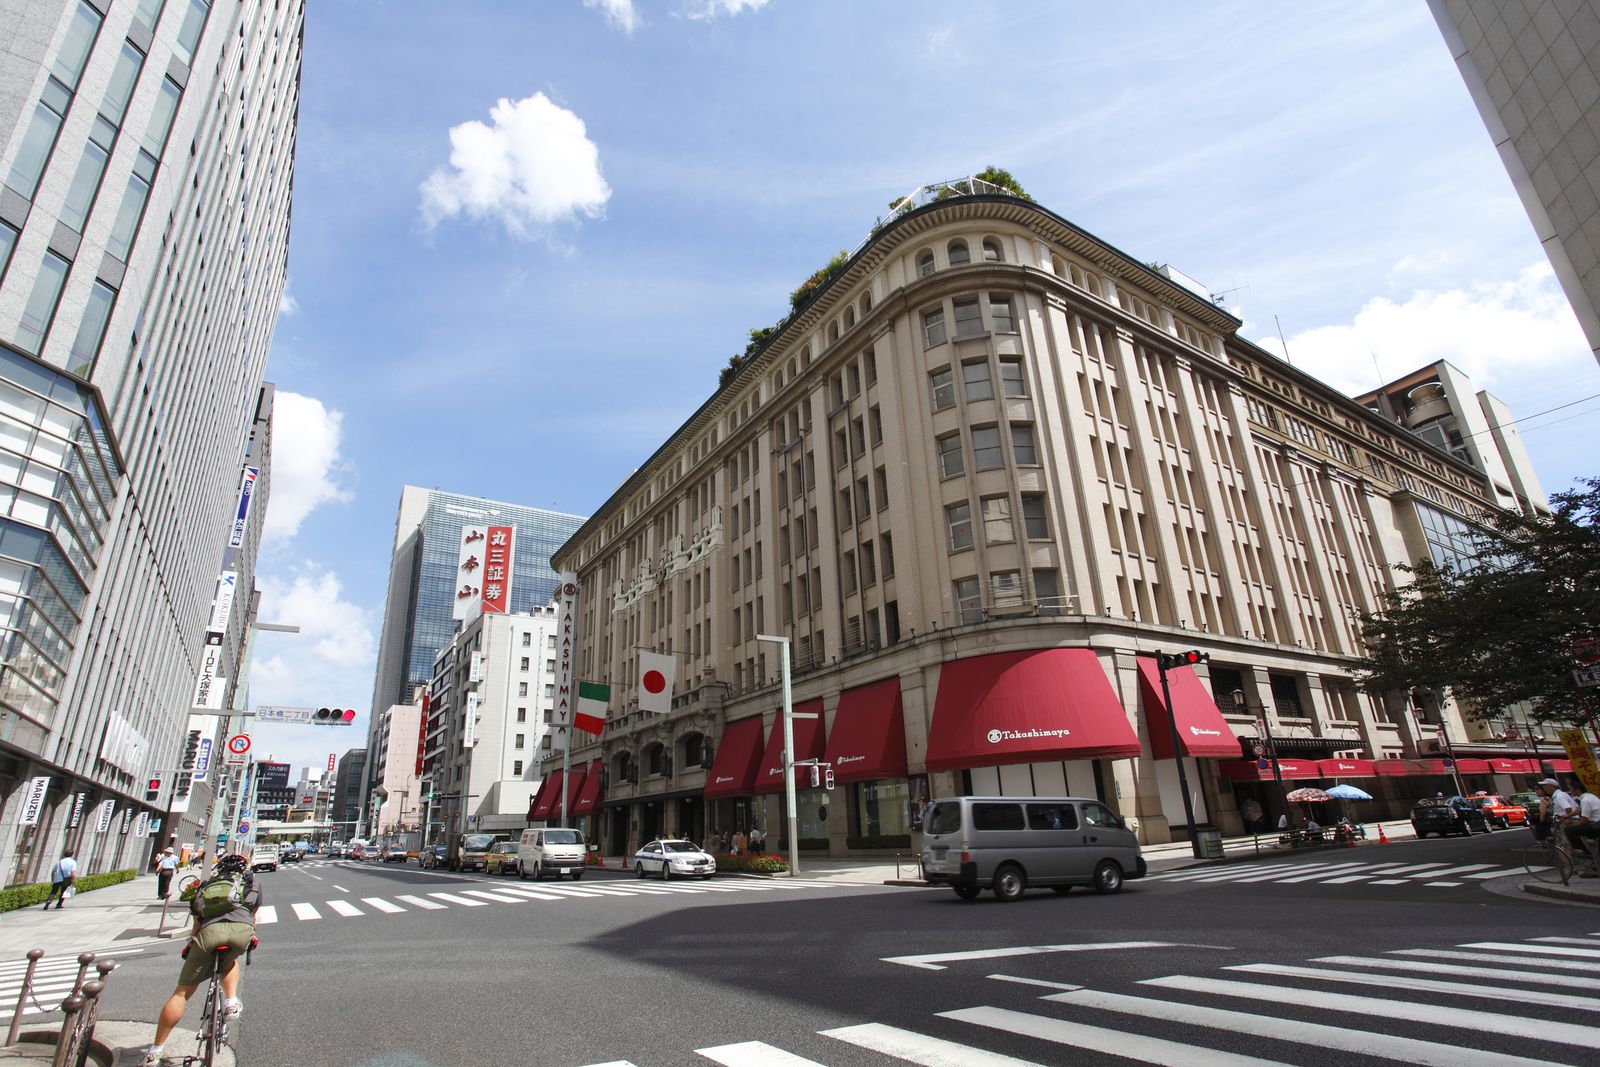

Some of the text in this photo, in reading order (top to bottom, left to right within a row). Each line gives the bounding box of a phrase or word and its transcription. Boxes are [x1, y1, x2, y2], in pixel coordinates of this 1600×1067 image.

[458, 530, 485, 599] 山本山
[486, 531, 507, 600] 丸三証券
[557, 600, 574, 734] TAKASHIMAYA
[259, 709, 309, 719] 日本橋二丁目
[1002, 728, 1070, 740] Takashimaya
[176, 729, 202, 797] MARUZEN
[25, 780, 45, 821] MARUZEN
[70, 793, 85, 827] MARUZEN
